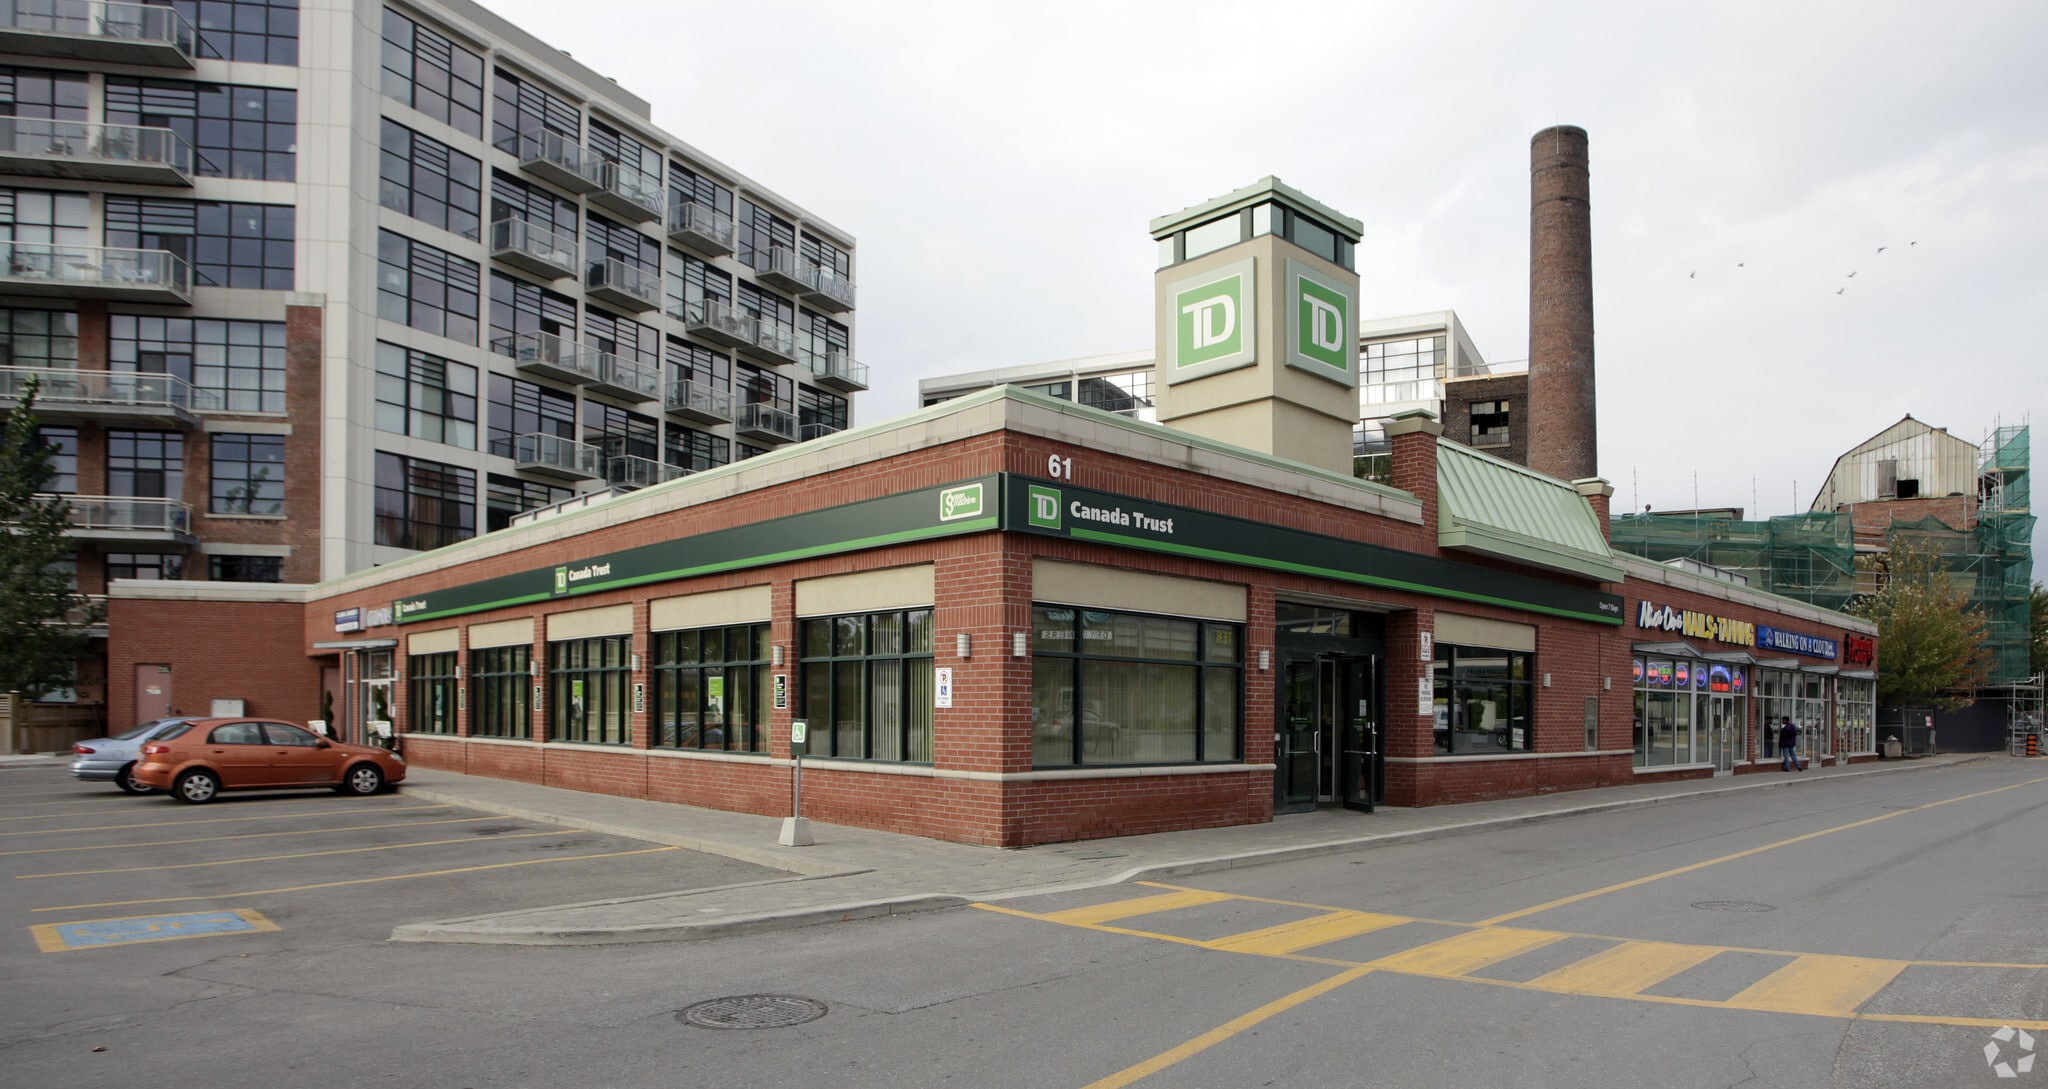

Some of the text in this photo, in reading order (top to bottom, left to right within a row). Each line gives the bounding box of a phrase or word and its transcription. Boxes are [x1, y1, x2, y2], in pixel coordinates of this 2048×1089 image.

[1182, 294, 1236, 350] TD
[1303, 293, 1343, 352] TD
[1048, 453, 1072, 481] 61
[1032, 493, 1174, 534] TD Canada Trust
[556, 562, 611, 588] TD Canada Trust
[1663, 605, 1683, 631] One
[1682, 609, 1714, 640] NAILS
[1774, 631, 1799, 651] WALKING
[1799, 636, 1807, 651] ON
[1812, 638, 1828, 655] CLOUD
